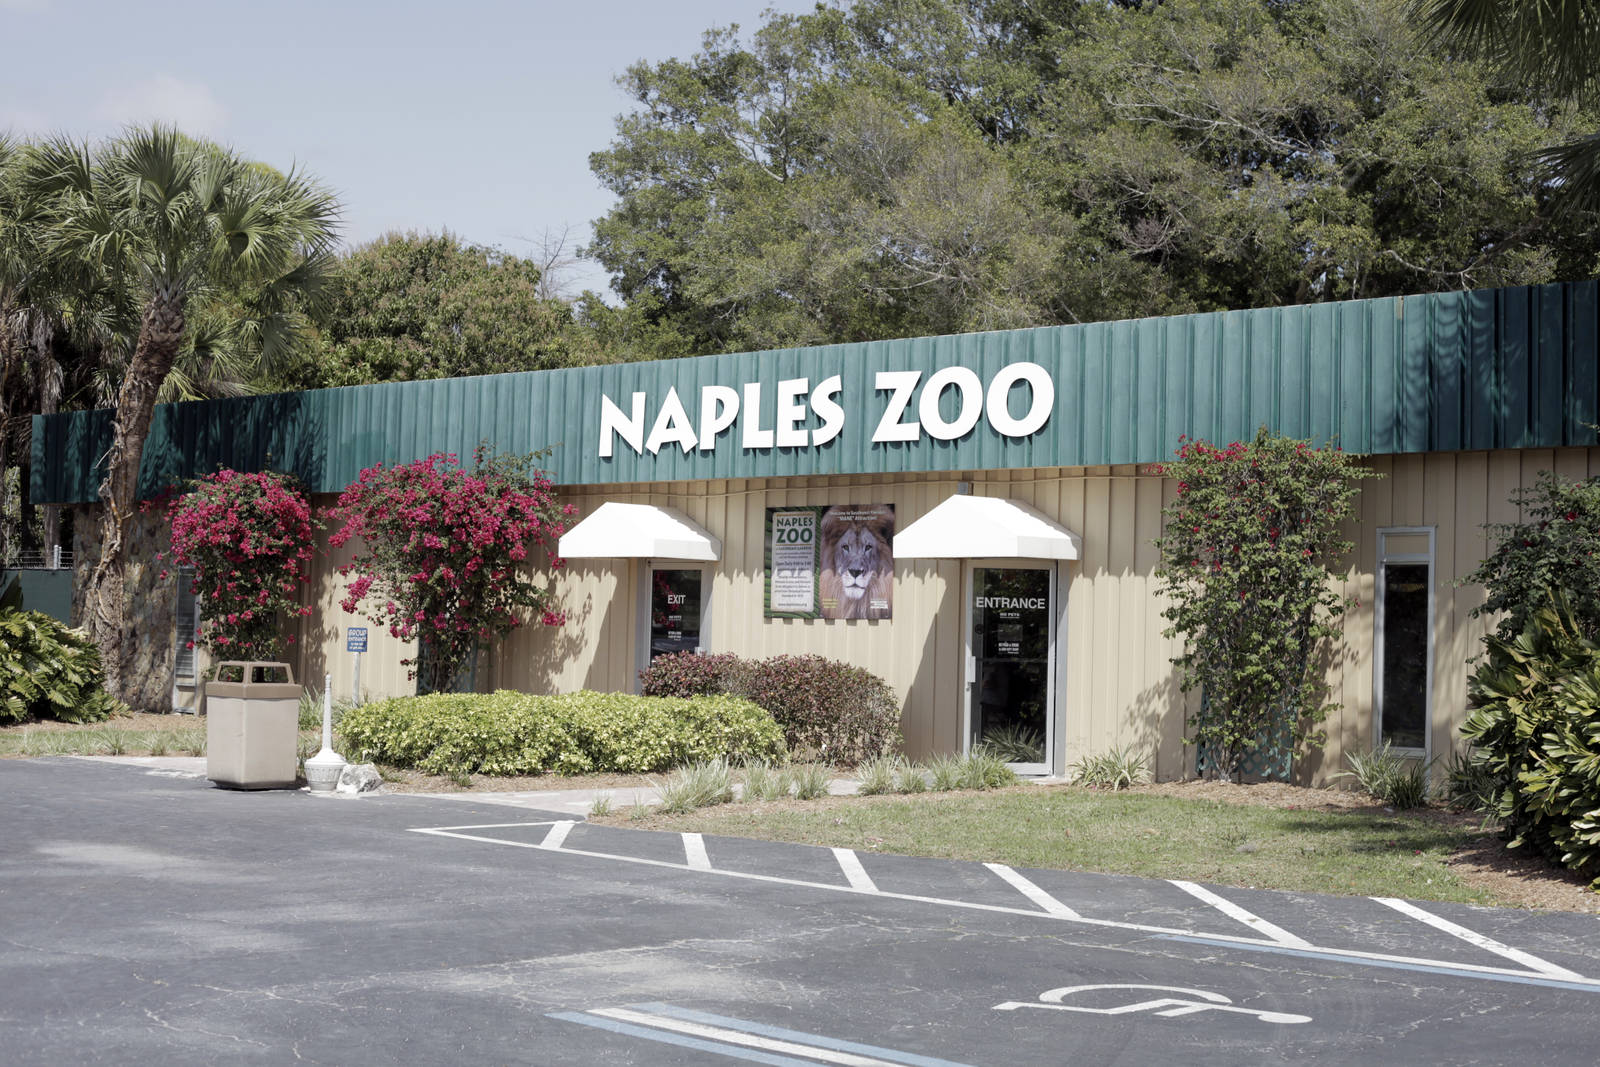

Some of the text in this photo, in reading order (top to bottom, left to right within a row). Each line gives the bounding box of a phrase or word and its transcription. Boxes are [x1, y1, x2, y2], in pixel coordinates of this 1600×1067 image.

[599, 361, 1055, 457] NAPLES ZOO
[776, 517, 813, 527] NAPLES
[776, 528, 813, 543] ZOO
[667, 594, 686, 604] EXIT
[976, 596, 1046, 609] ENTRANCE
